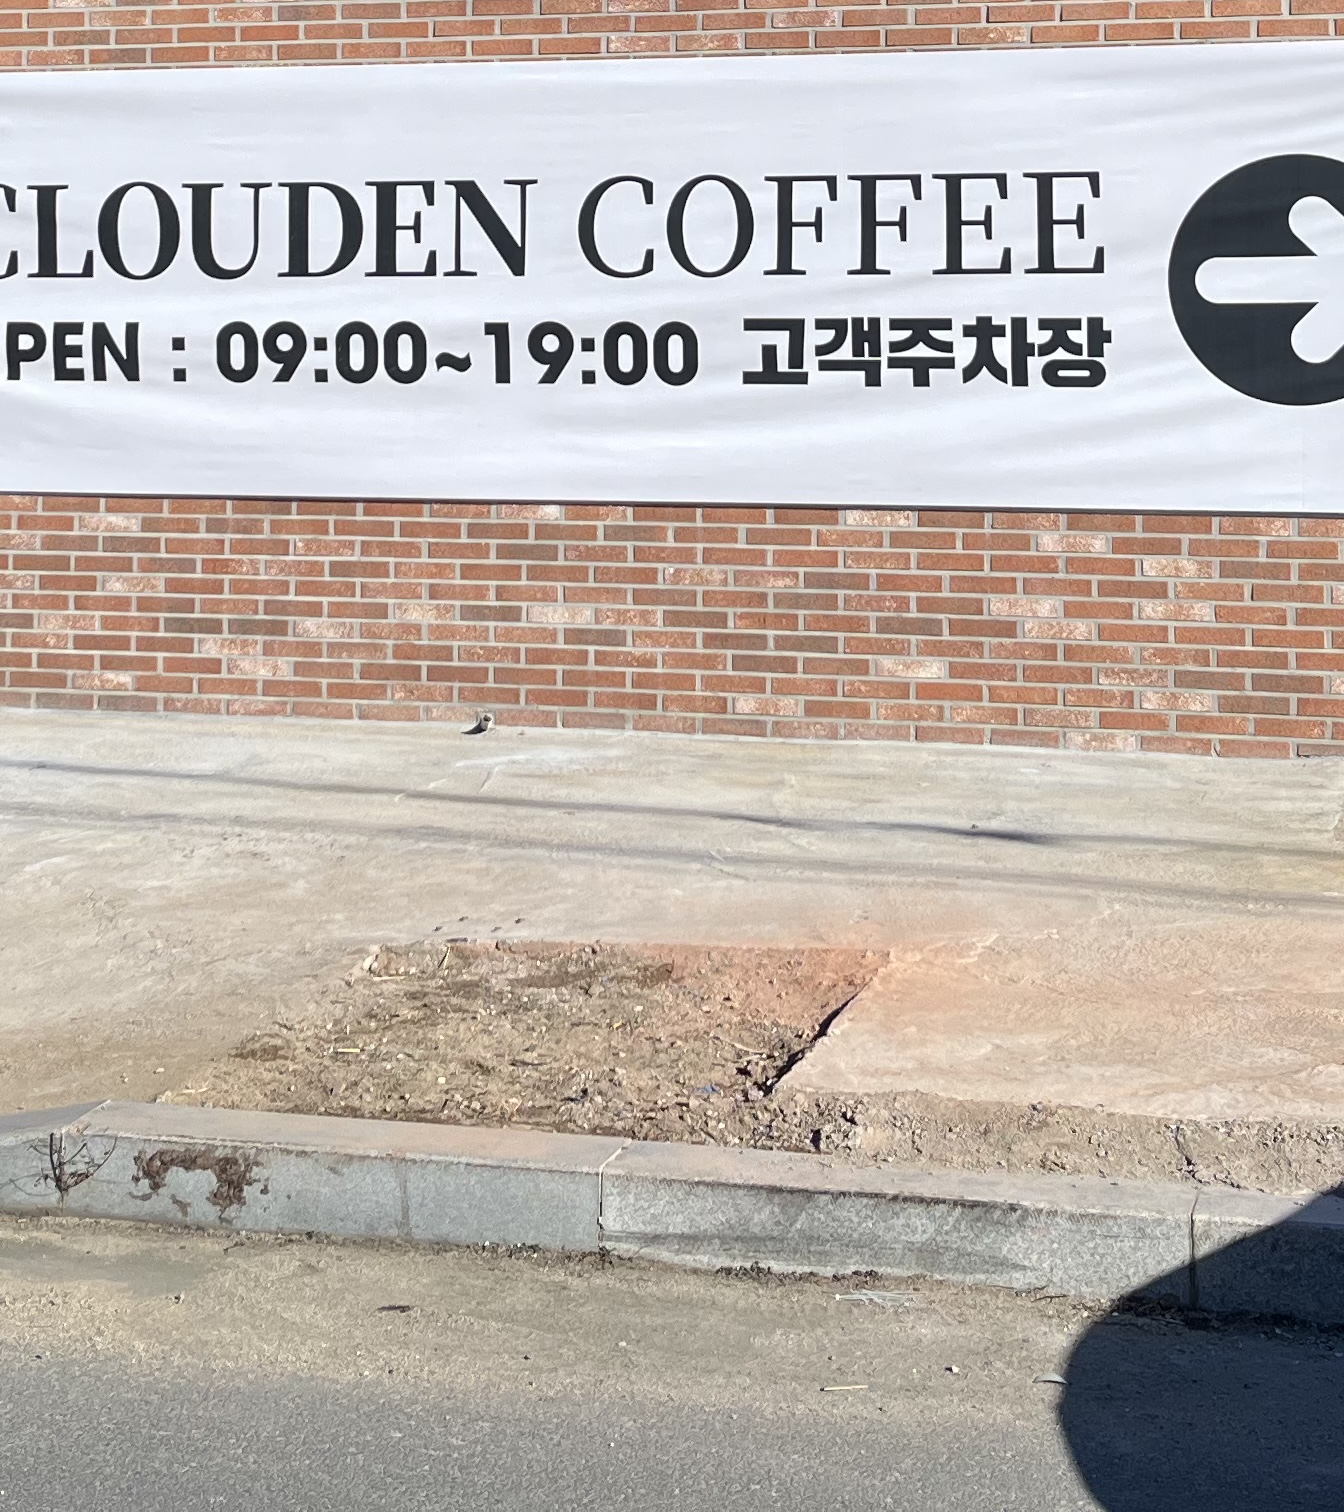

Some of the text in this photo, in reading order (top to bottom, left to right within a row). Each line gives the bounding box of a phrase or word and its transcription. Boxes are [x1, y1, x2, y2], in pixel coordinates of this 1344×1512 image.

[577, 171, 1106, 279] COFFEE
[215, 319, 699, 386] 09:00~19:00
[741, 315, 1113, 388] 고객주차장
